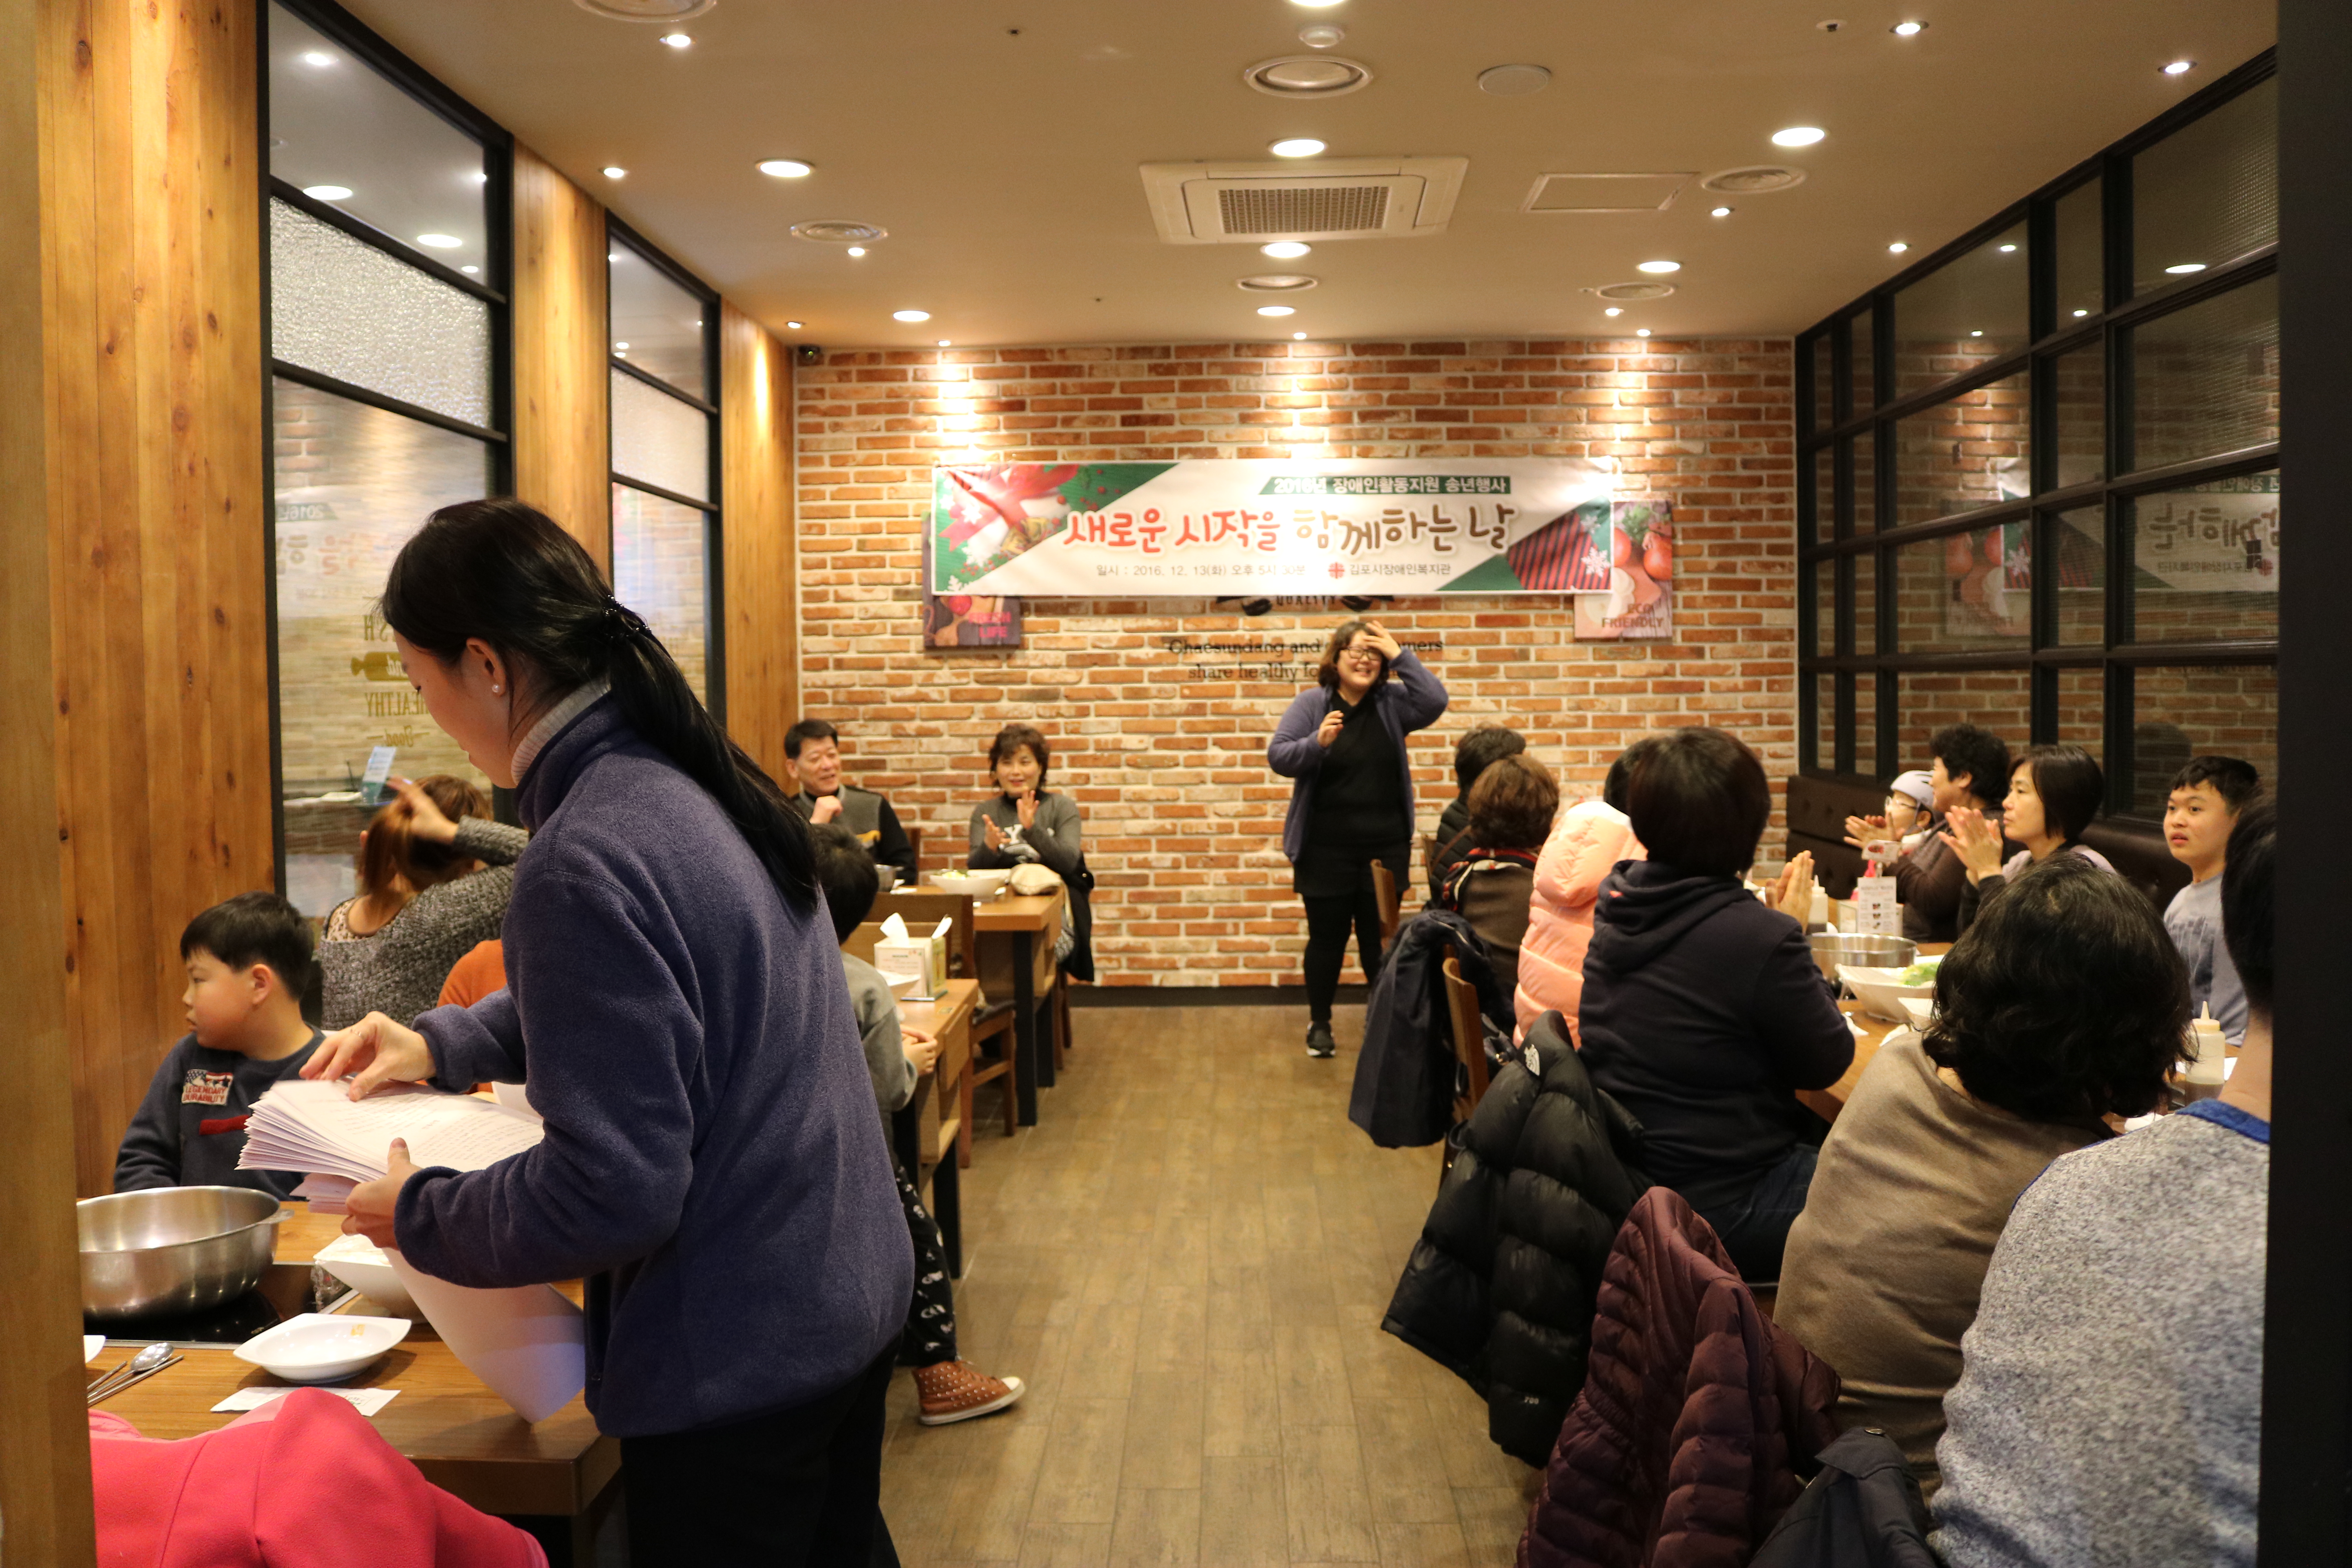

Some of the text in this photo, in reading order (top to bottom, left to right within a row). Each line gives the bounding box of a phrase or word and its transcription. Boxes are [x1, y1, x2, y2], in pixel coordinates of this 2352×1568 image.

[1273, 477, 1506, 493] 2016년 장애인활동지원 송년행사
[1063, 503, 1515, 555] 새로운 시작을 함께하는 날
[1096, 565, 1119, 576] 일시
[1133, 565, 1165, 576] 2016.
[1171, 565, 1187, 576] 12.
[1194, 565, 1227, 576] 13(화)
[1232, 564, 1254, 576] 오후
[1258, 564, 1276, 576] 5시
[1350, 563, 1451, 575] 김포시장애인복지관
[1602, 617, 1664, 628] FRIENDLY
[979, 626, 1008, 638] LIFE
[1170, 638, 1320, 657] Chaesundang and
[1188, 663, 1232, 679] share
[1238, 662, 1299, 682] healthy
[185, 1085, 228, 1094] LEGENDARY
[183, 1093, 225, 1103] DURABILITY
